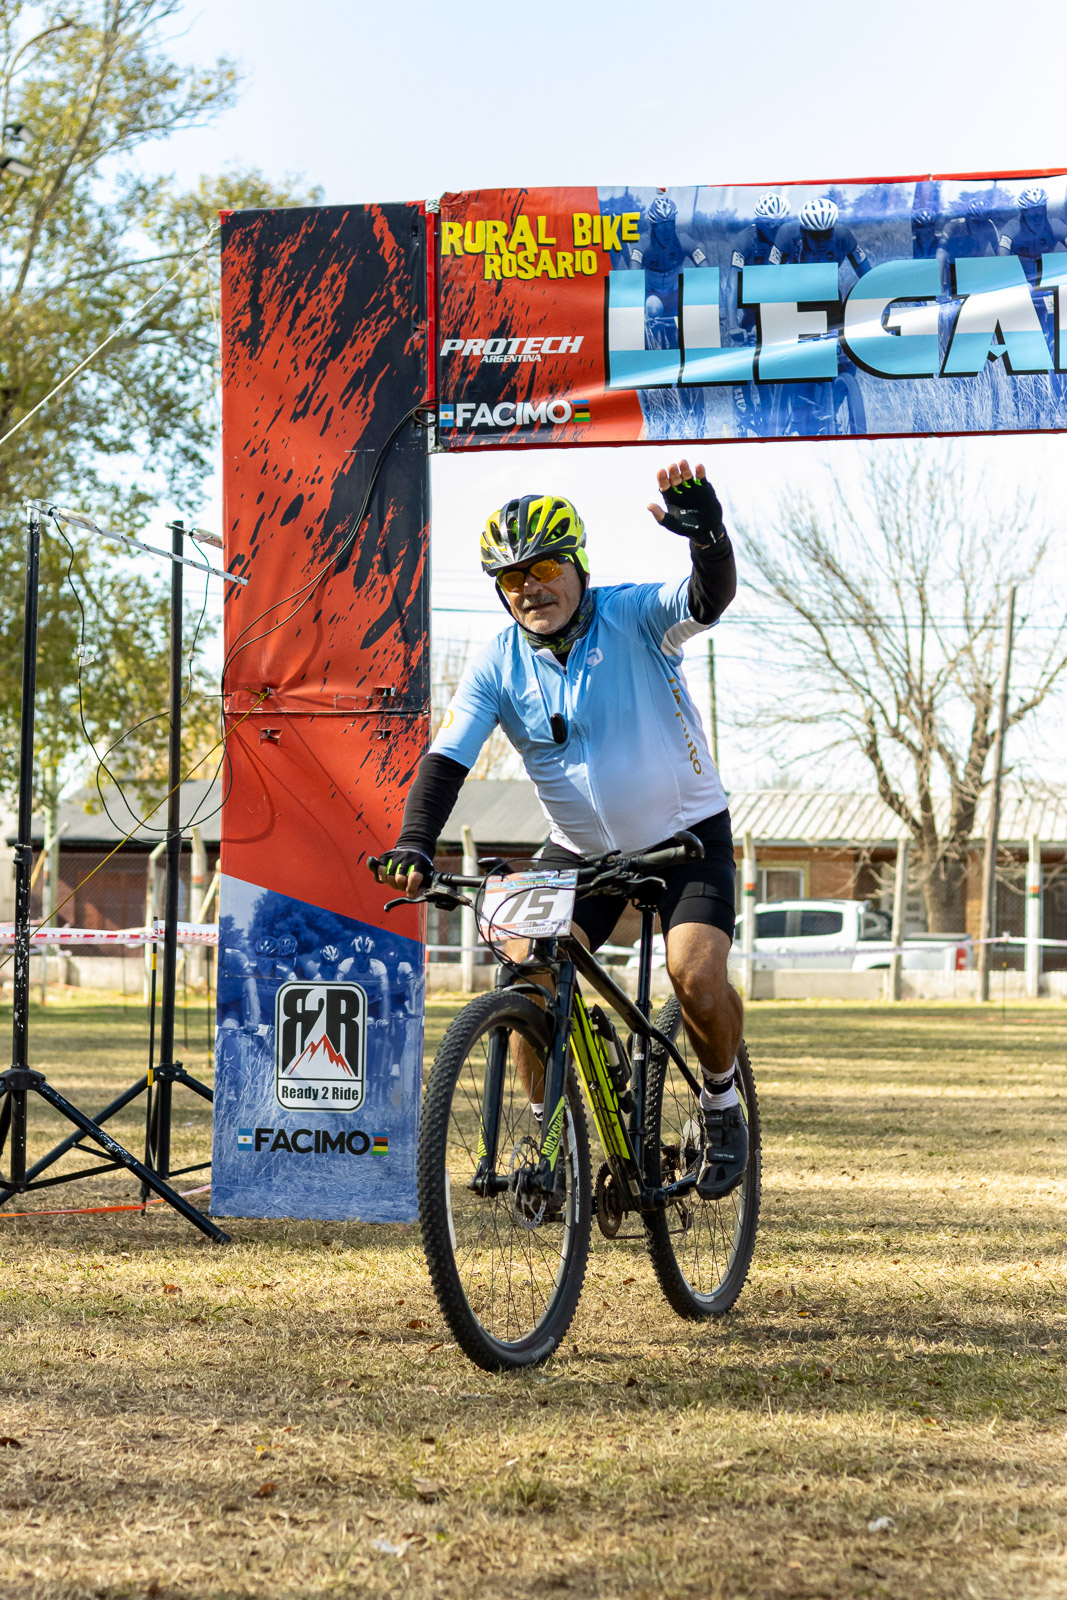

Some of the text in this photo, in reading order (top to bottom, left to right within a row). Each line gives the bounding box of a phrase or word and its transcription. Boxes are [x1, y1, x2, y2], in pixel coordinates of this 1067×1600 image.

[441, 211, 641, 257] RURAL BIKE
[483, 249, 598, 281] ROSARIO
[605, 251, 1067, 391] LLEGA
[440, 335, 585, 357] PROTECH
[480, 353, 543, 364] ARGENTINA
[455, 400, 572, 427] FACIMO
[501, 888, 560, 924] 75
[281, 1085, 360, 1101] Ready 2 Ride
[254, 1127, 371, 1156] FACIMO
